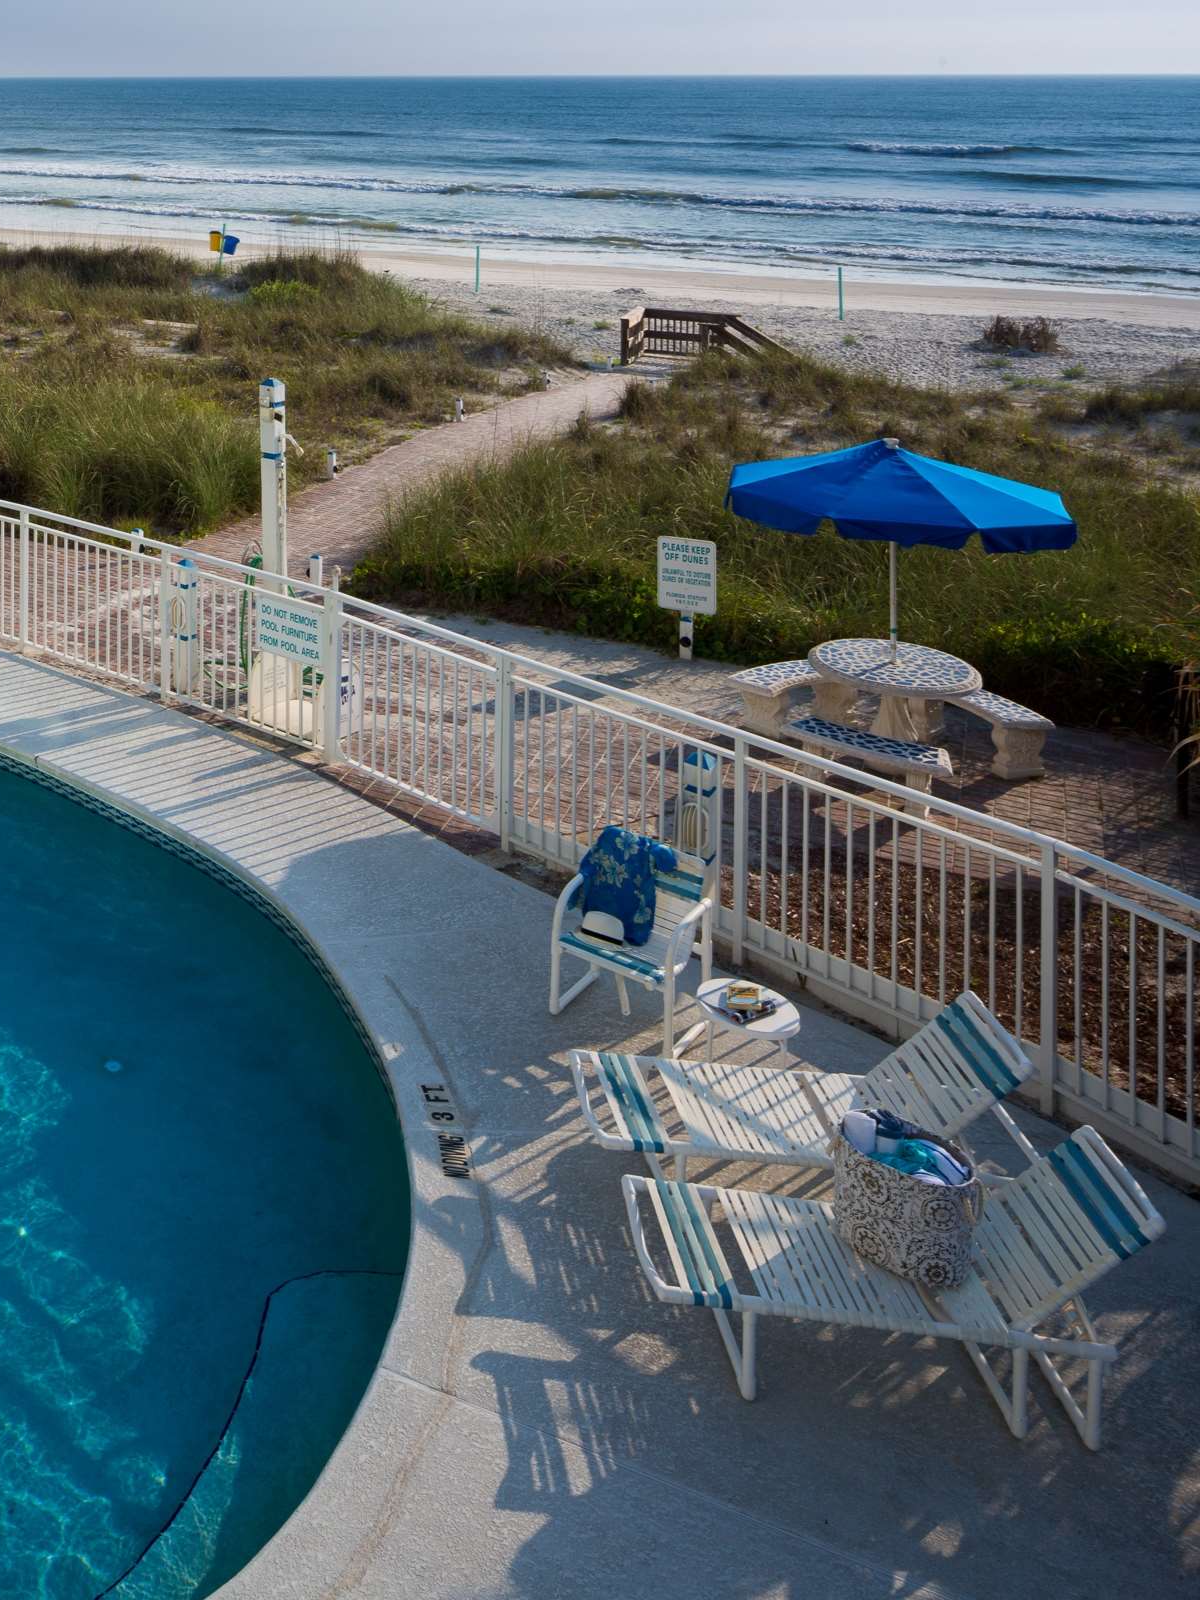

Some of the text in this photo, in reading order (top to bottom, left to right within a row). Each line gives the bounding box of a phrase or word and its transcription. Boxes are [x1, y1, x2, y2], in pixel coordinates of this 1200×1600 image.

[662, 542, 711, 555] PLEASE KEEP
[664, 552, 709, 565] OFF DUNES
[261, 604, 318, 629] DO NOT REMOVE
[261, 619, 318, 645] POOL FURNITURE
[260, 633, 320, 660] FROM POOL AREA
[431, 1111, 455, 1121] 3
